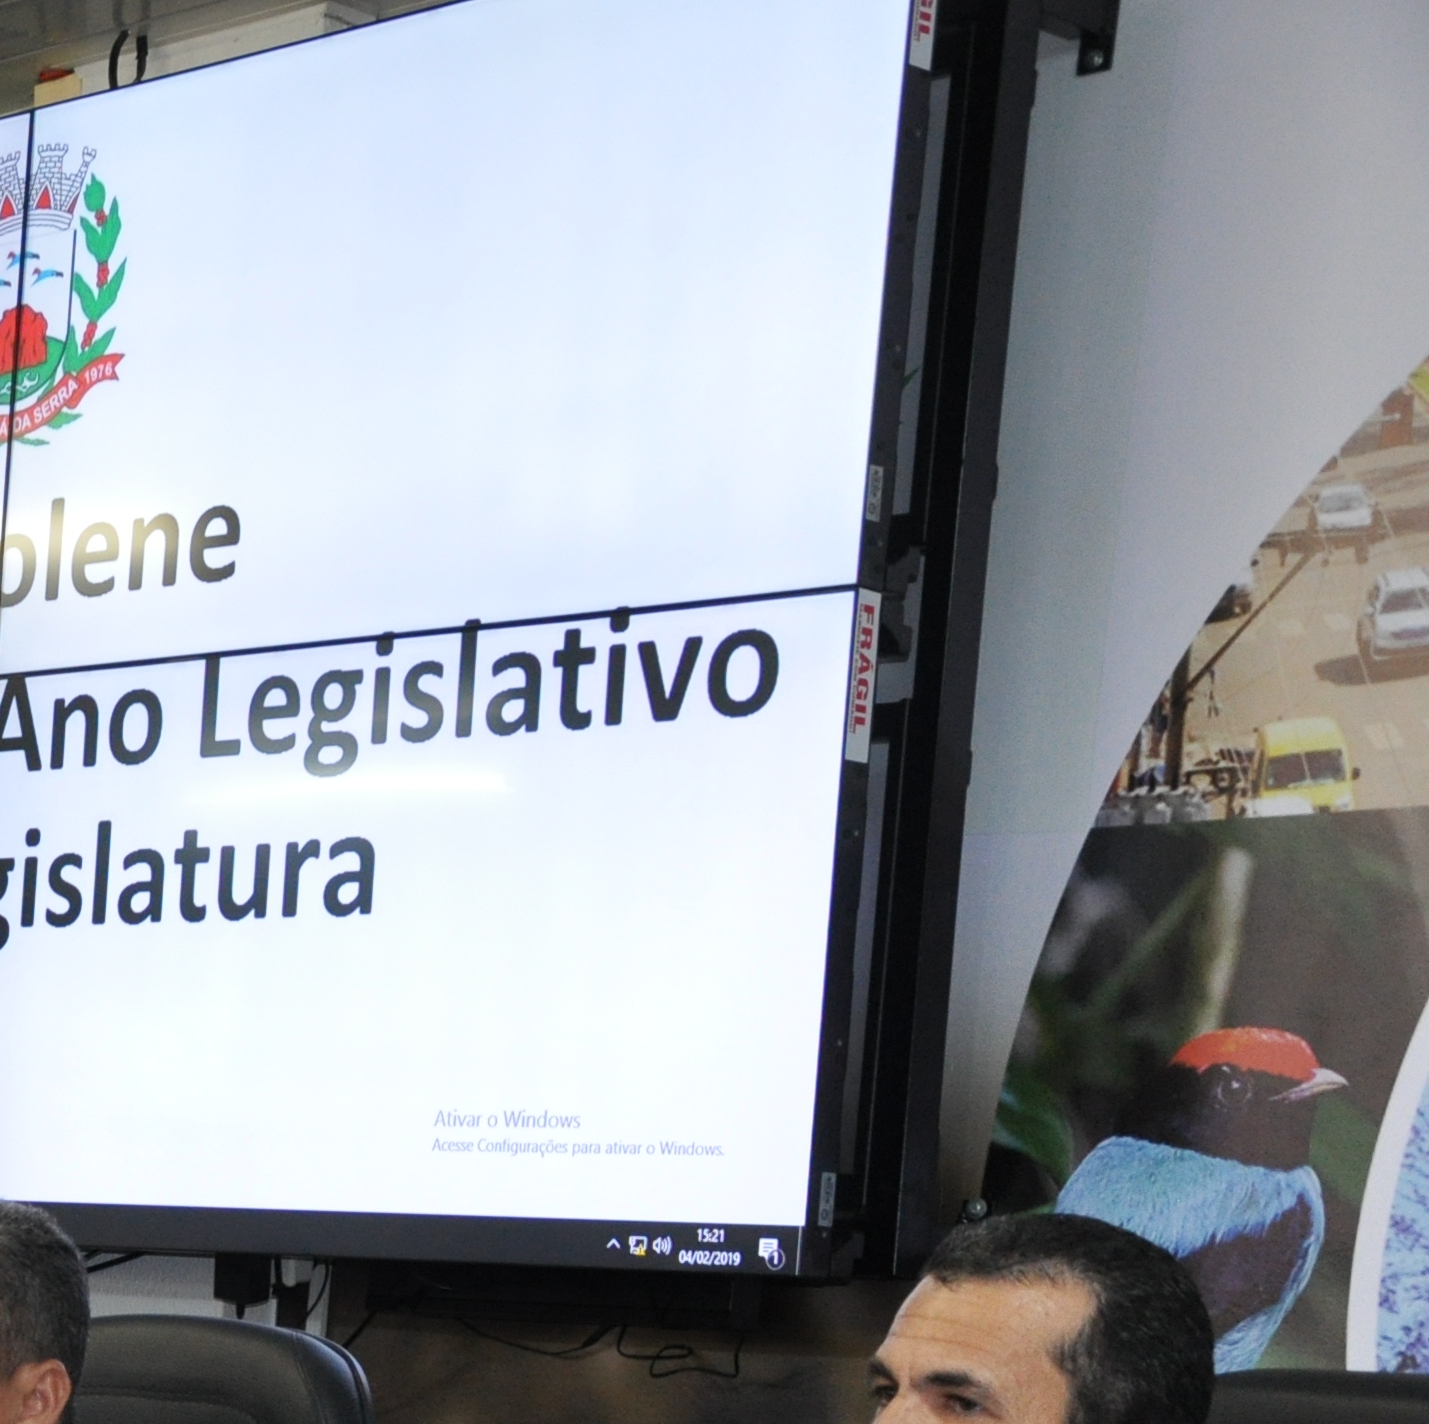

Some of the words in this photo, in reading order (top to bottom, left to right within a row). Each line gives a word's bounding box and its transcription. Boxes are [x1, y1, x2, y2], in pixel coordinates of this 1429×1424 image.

[84, 362, 113, 384] 1976
[33, 379, 79, 424] SERRA
[855, 604, 875, 732] FRÁGIL
[198, 606, 781, 777] Legislativo
[434, 1109, 481, 1128] Ativar
[487, 1115, 498, 1128] o
[503, 1110, 581, 1129] Windows
[432, 1138, 474, 1153] Acesse
[477, 1138, 569, 1157] Configurações
[572, 1143, 601, 1156] para
[605, 1141, 642, 1155] ativar
[646, 1145, 655, 1155] o
[659, 1141, 725, 1157] Windows.
[697, 1228, 725, 1243] 15:21
[679, 1250, 741, 1267] 04/02/2019
